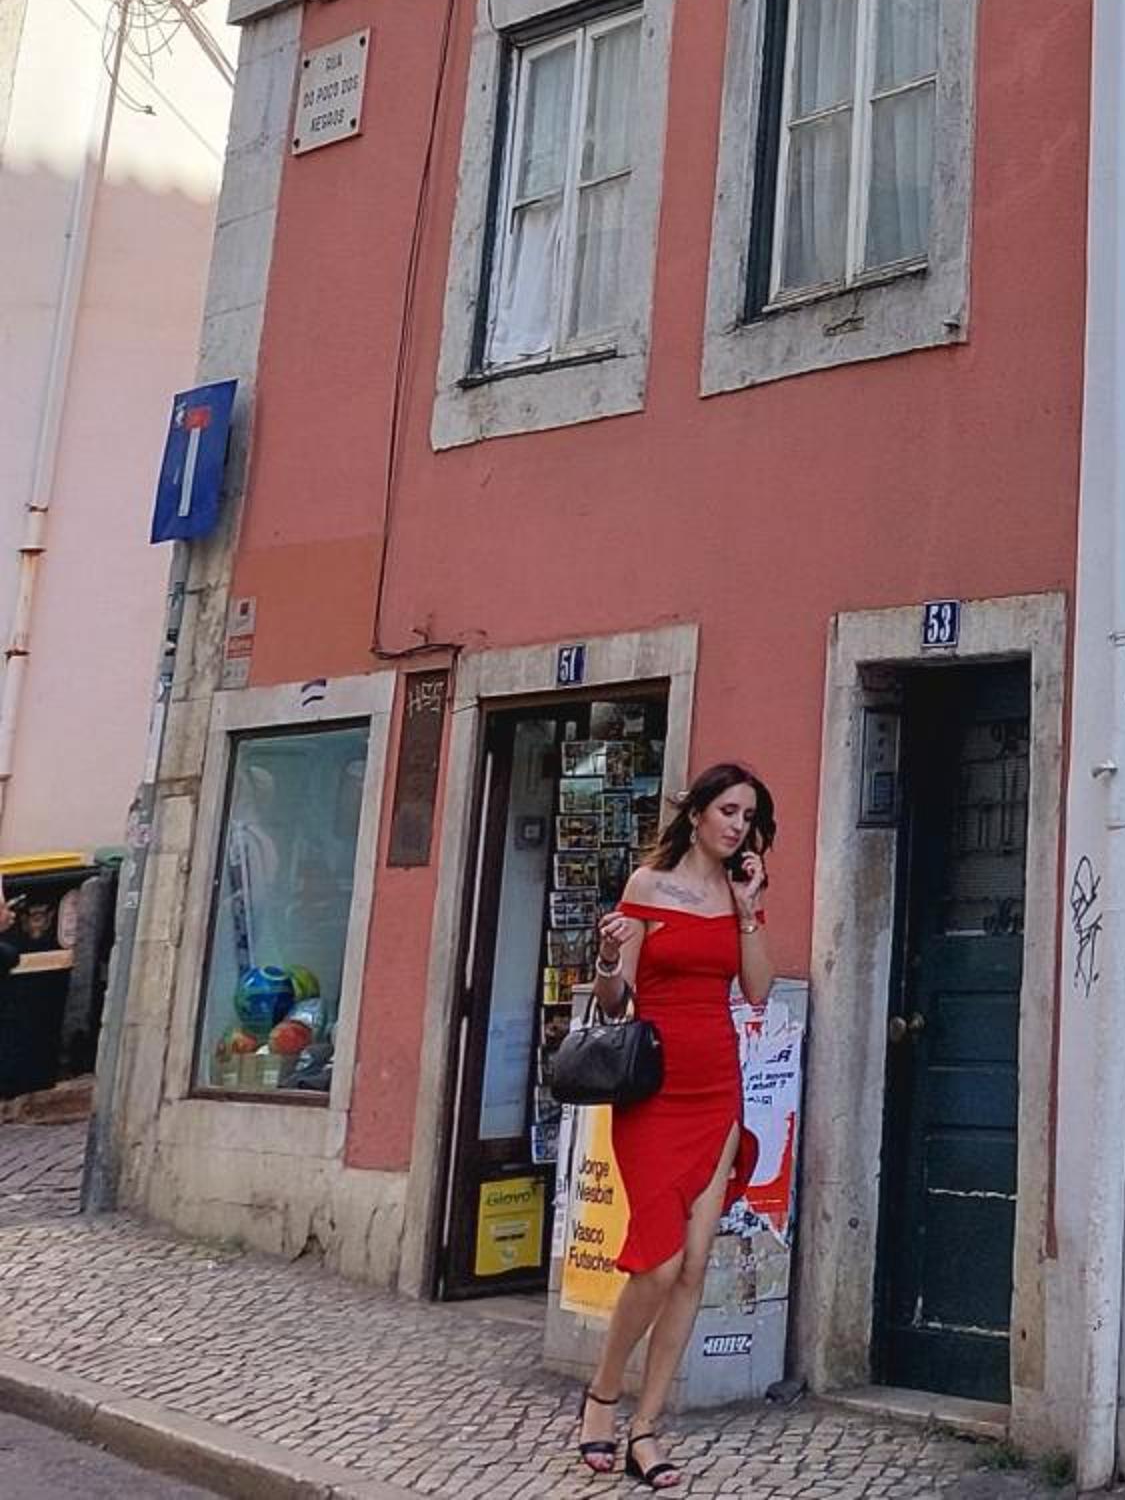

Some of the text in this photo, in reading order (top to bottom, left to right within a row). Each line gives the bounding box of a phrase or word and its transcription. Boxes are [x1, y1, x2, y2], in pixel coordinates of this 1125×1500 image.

[927, 604, 951, 642] 53
[559, 647, 577, 682] 51
[577, 1154, 610, 1181] Jorge
[575, 1181, 614, 1206] Nesbitt
[571, 1218, 605, 1244] Vasco
